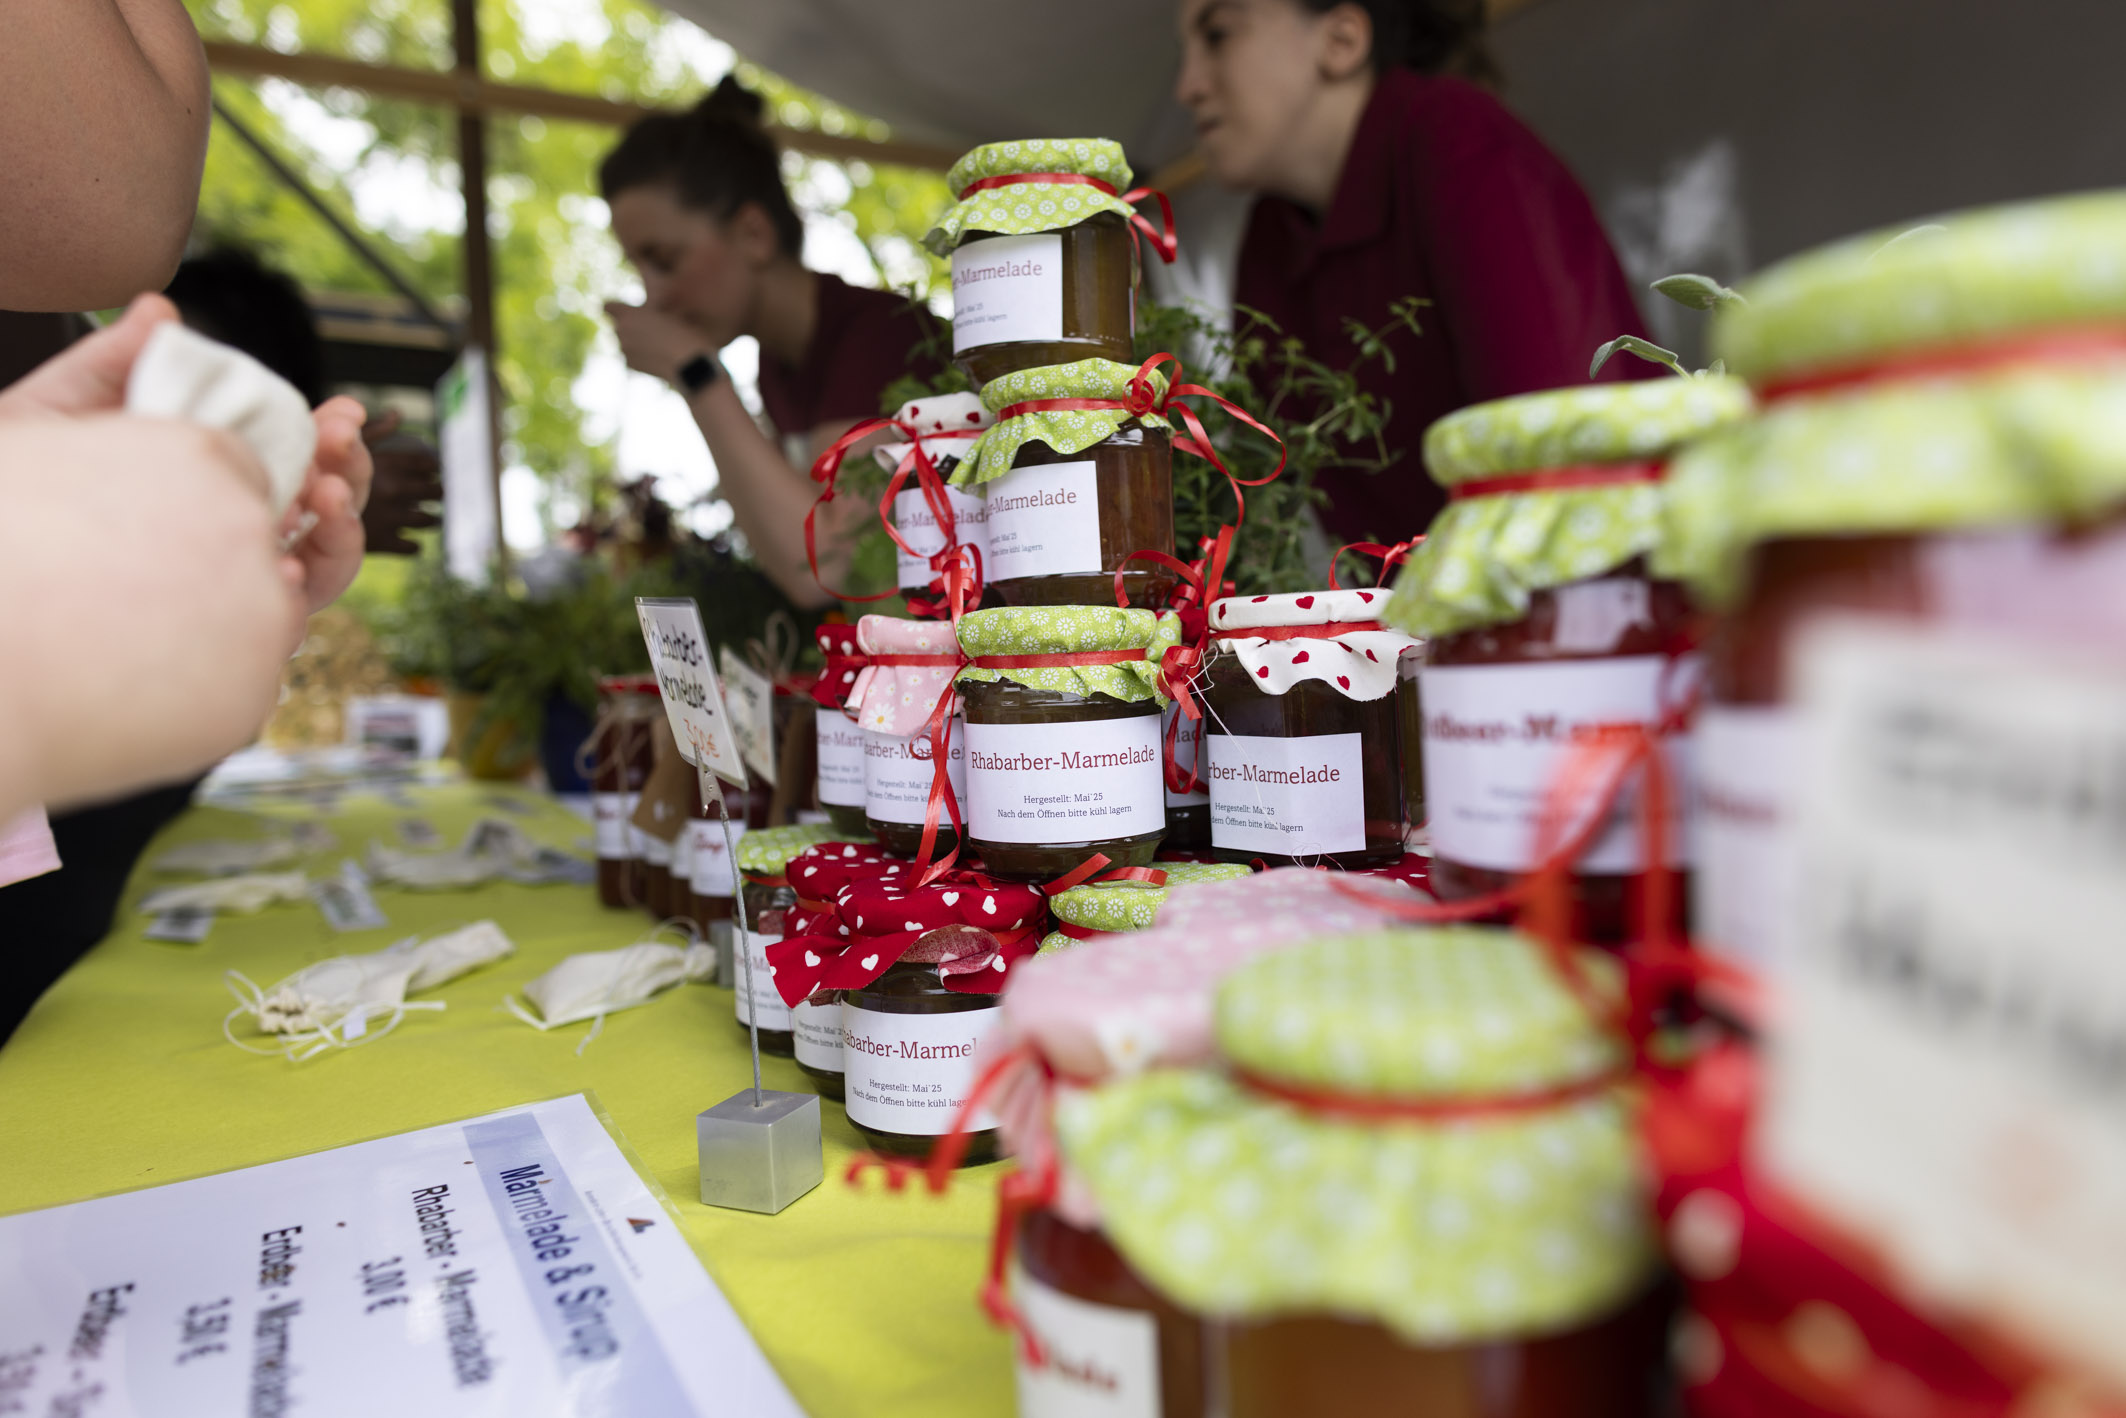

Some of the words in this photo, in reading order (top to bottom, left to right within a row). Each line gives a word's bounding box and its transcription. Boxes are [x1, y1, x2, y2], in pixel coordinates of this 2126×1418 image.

[1021, 543, 1043, 553] lagern
[971, 744, 1155, 772] Rhabarber-Marmelade
[1023, 794, 1072, 806] Hergestellt:
[997, 808, 1016, 819] Nach
[1017, 809, 1035, 819] dem
[1037, 807, 1066, 819] Öffnen
[1068, 807, 1087, 818] bitte
[1089, 806, 1107, 817] kühl
[1109, 805, 1132, 815] lagern
[1215, 802, 1251, 814] Hergestellt:
[1225, 816, 1247, 827] Öffnen
[1248, 819, 1262, 829] bitte
[1280, 822, 1303, 834] lagern
[869, 1078, 910, 1093] Hergestellt:
[866, 1092, 878, 1103] dem
[879, 1095, 905, 1108] Öffnen
[906, 1098, 926, 1108] bitte
[928, 1099, 947, 1108] kühl
[412, 1183, 463, 1260] Rhabarber
[500, 1163, 580, 1263] Marmelade
[545, 1262, 596, 1287] &
